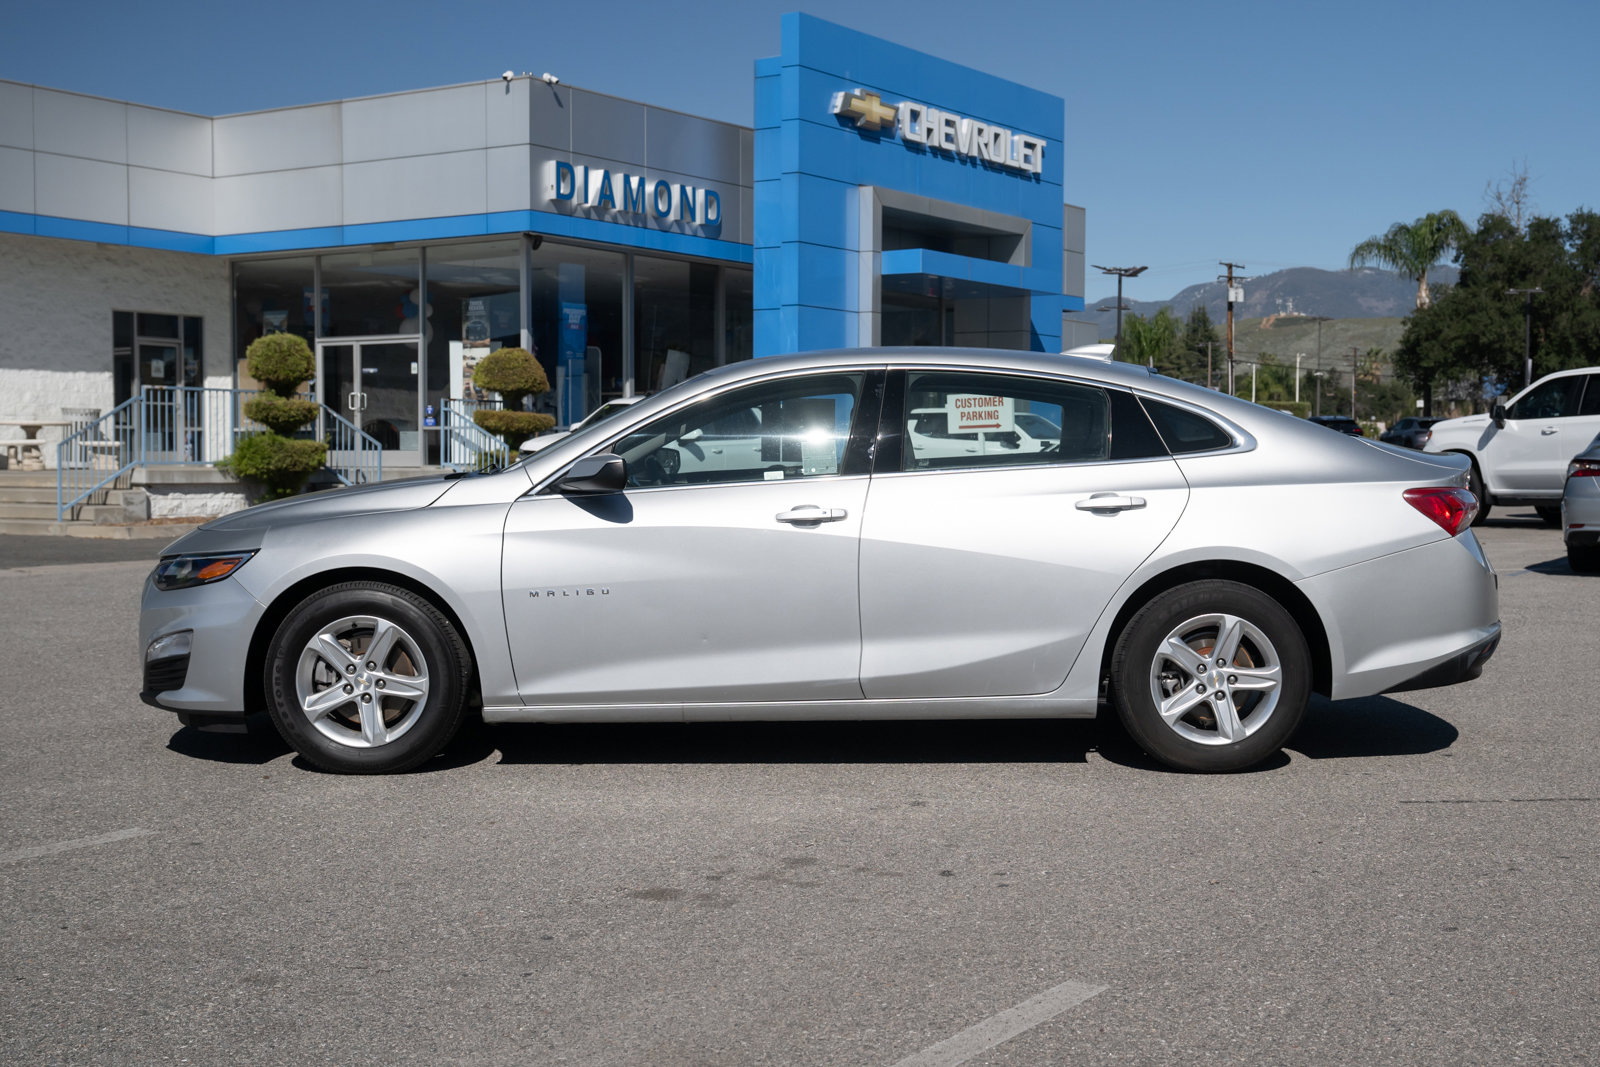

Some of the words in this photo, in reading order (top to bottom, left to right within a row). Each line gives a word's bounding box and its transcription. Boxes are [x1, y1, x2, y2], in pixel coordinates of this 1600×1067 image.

[899, 101, 1047, 174] CHEVROLET
[553, 160, 721, 226] DIAMOND
[955, 396, 1004, 409] CUSTOMER
[960, 409, 1000, 421] PARKING
[528, 586, 610, 598] MALIBU
